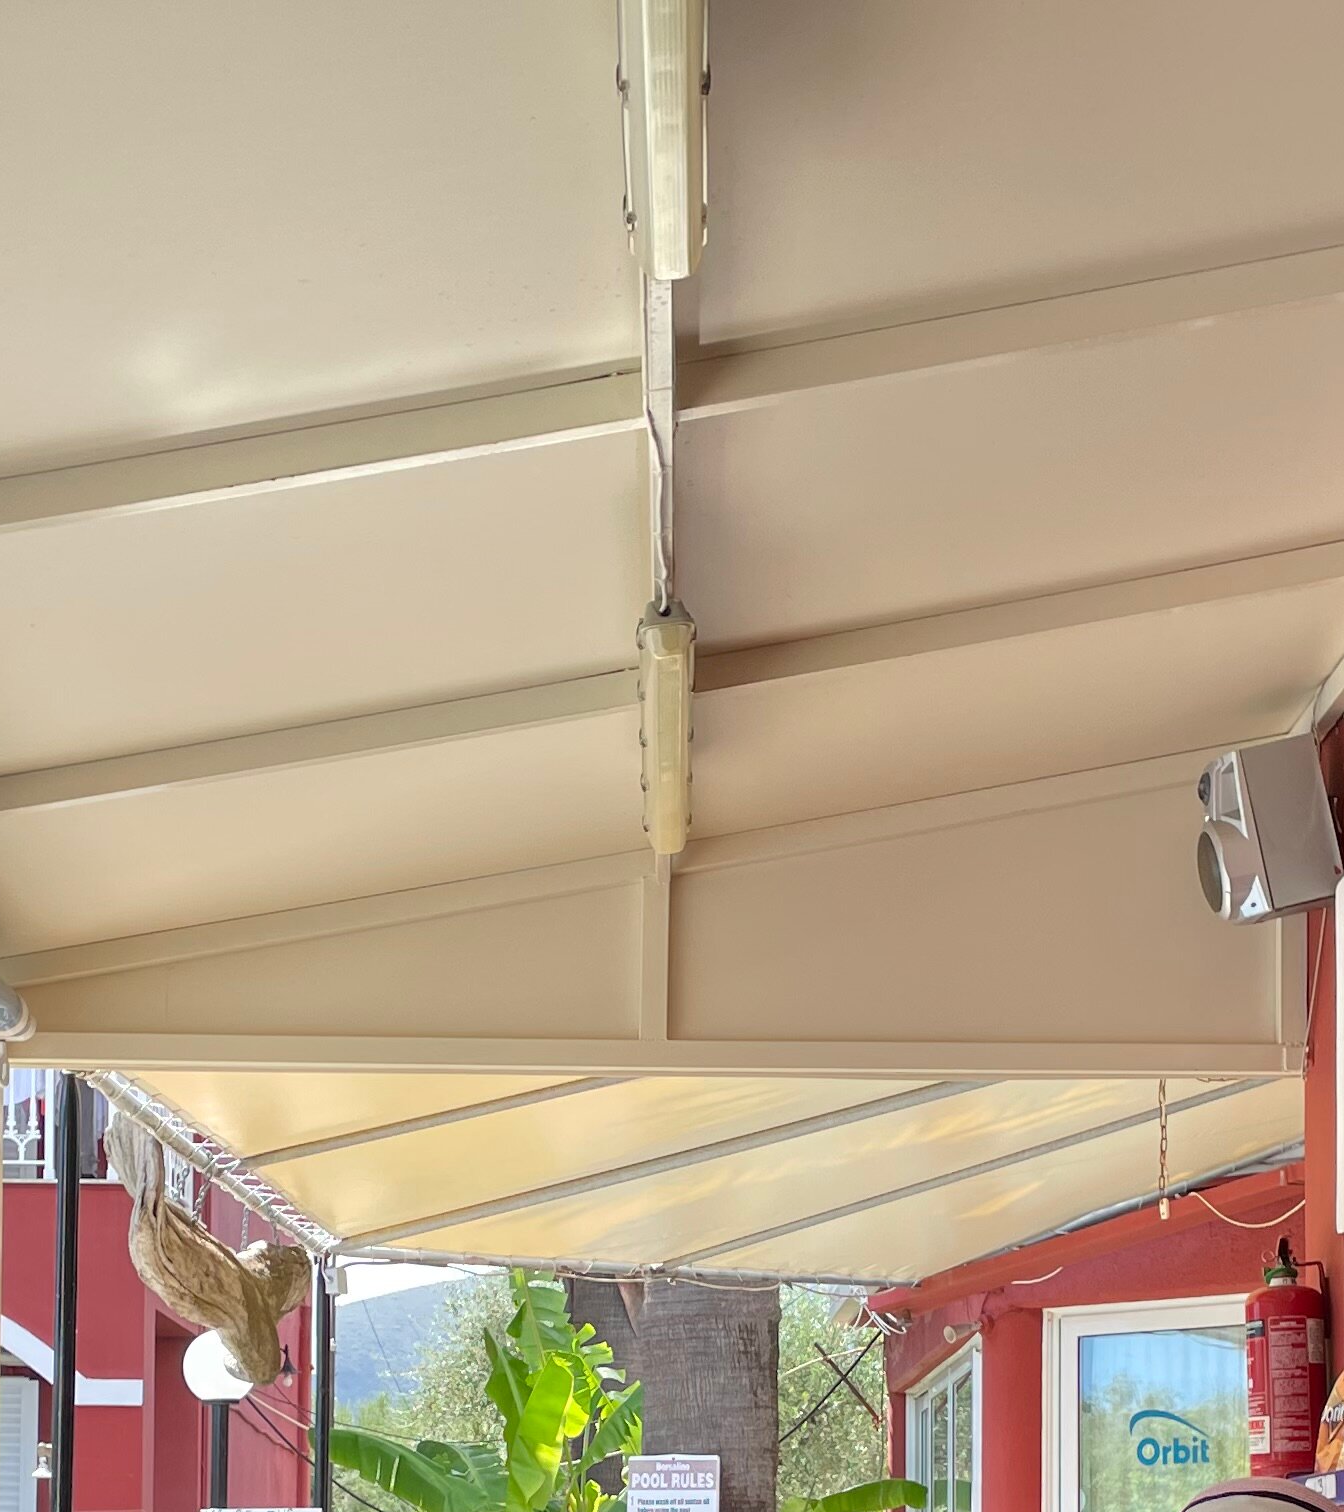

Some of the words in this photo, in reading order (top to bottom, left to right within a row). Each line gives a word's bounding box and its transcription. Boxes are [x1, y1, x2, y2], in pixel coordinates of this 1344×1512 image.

[1137, 1436, 1210, 1466] Orbit
[656, 1462, 690, 1471] Borsalino
[632, 1473, 668, 1488] POOL
[671, 1473, 714, 1488] RULES
